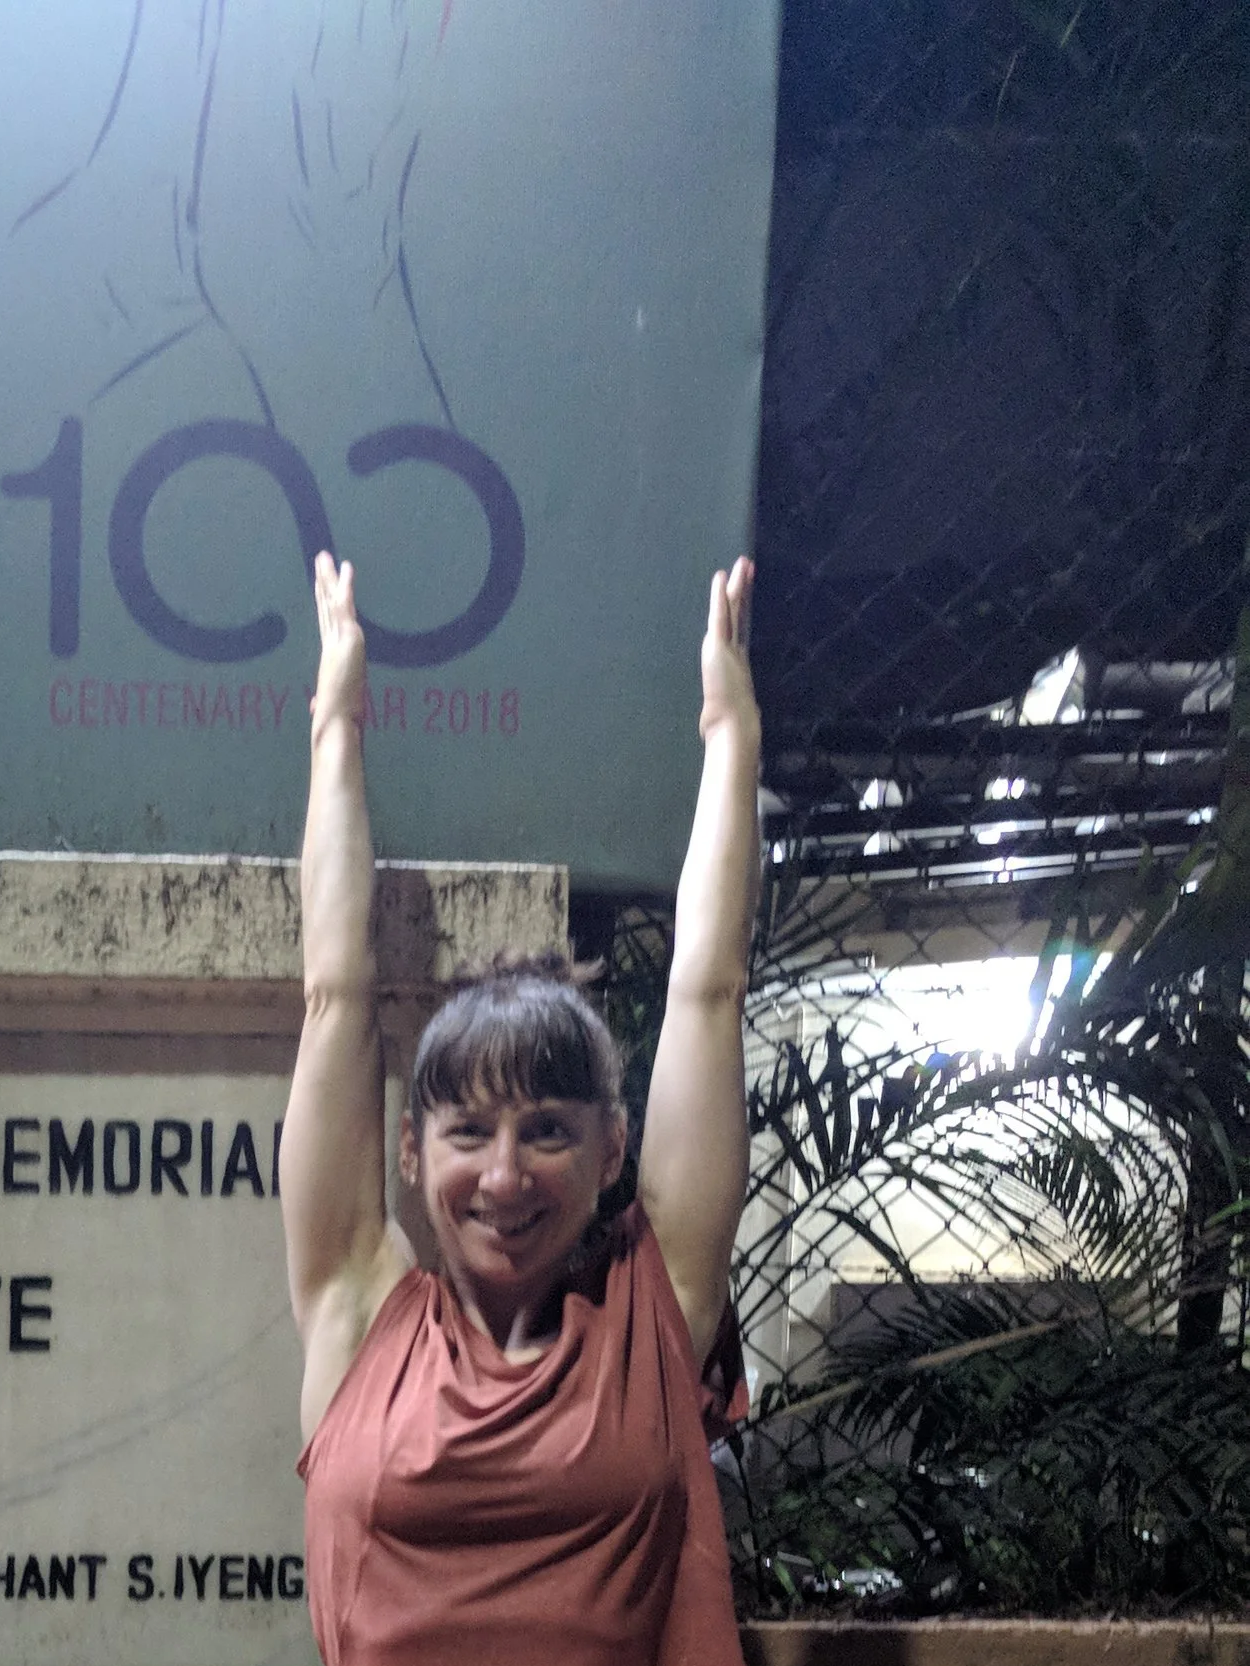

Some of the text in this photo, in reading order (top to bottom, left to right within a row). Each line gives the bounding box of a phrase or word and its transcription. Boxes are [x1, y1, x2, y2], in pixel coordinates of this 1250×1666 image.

[0, 415, 525, 668] 100
[49, 678, 290, 732] CENTENARY
[424, 686, 520, 736] 2018
